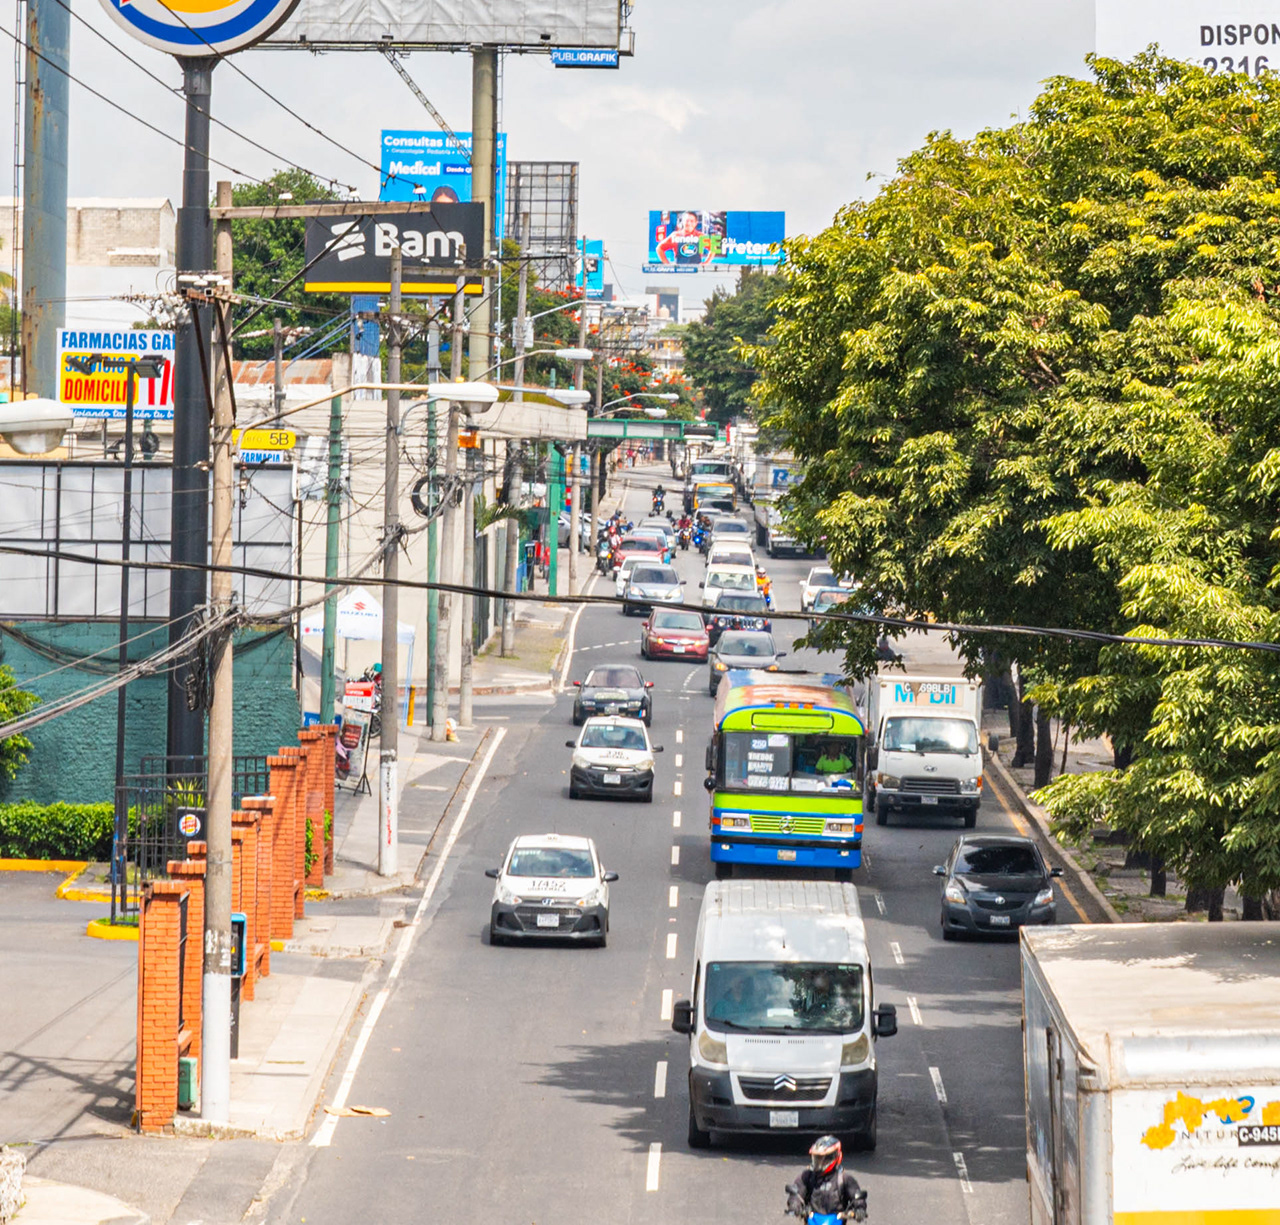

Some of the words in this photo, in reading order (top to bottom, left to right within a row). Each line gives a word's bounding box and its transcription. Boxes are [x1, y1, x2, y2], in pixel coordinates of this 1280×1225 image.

[552, 51, 616, 62] PUBLIGRAFIK
[383, 136, 443, 147] Consultas
[375, 223, 466, 257] Bam
[62, 332, 147, 350] FARMACIAS
[269, 432, 289, 446] 5B
